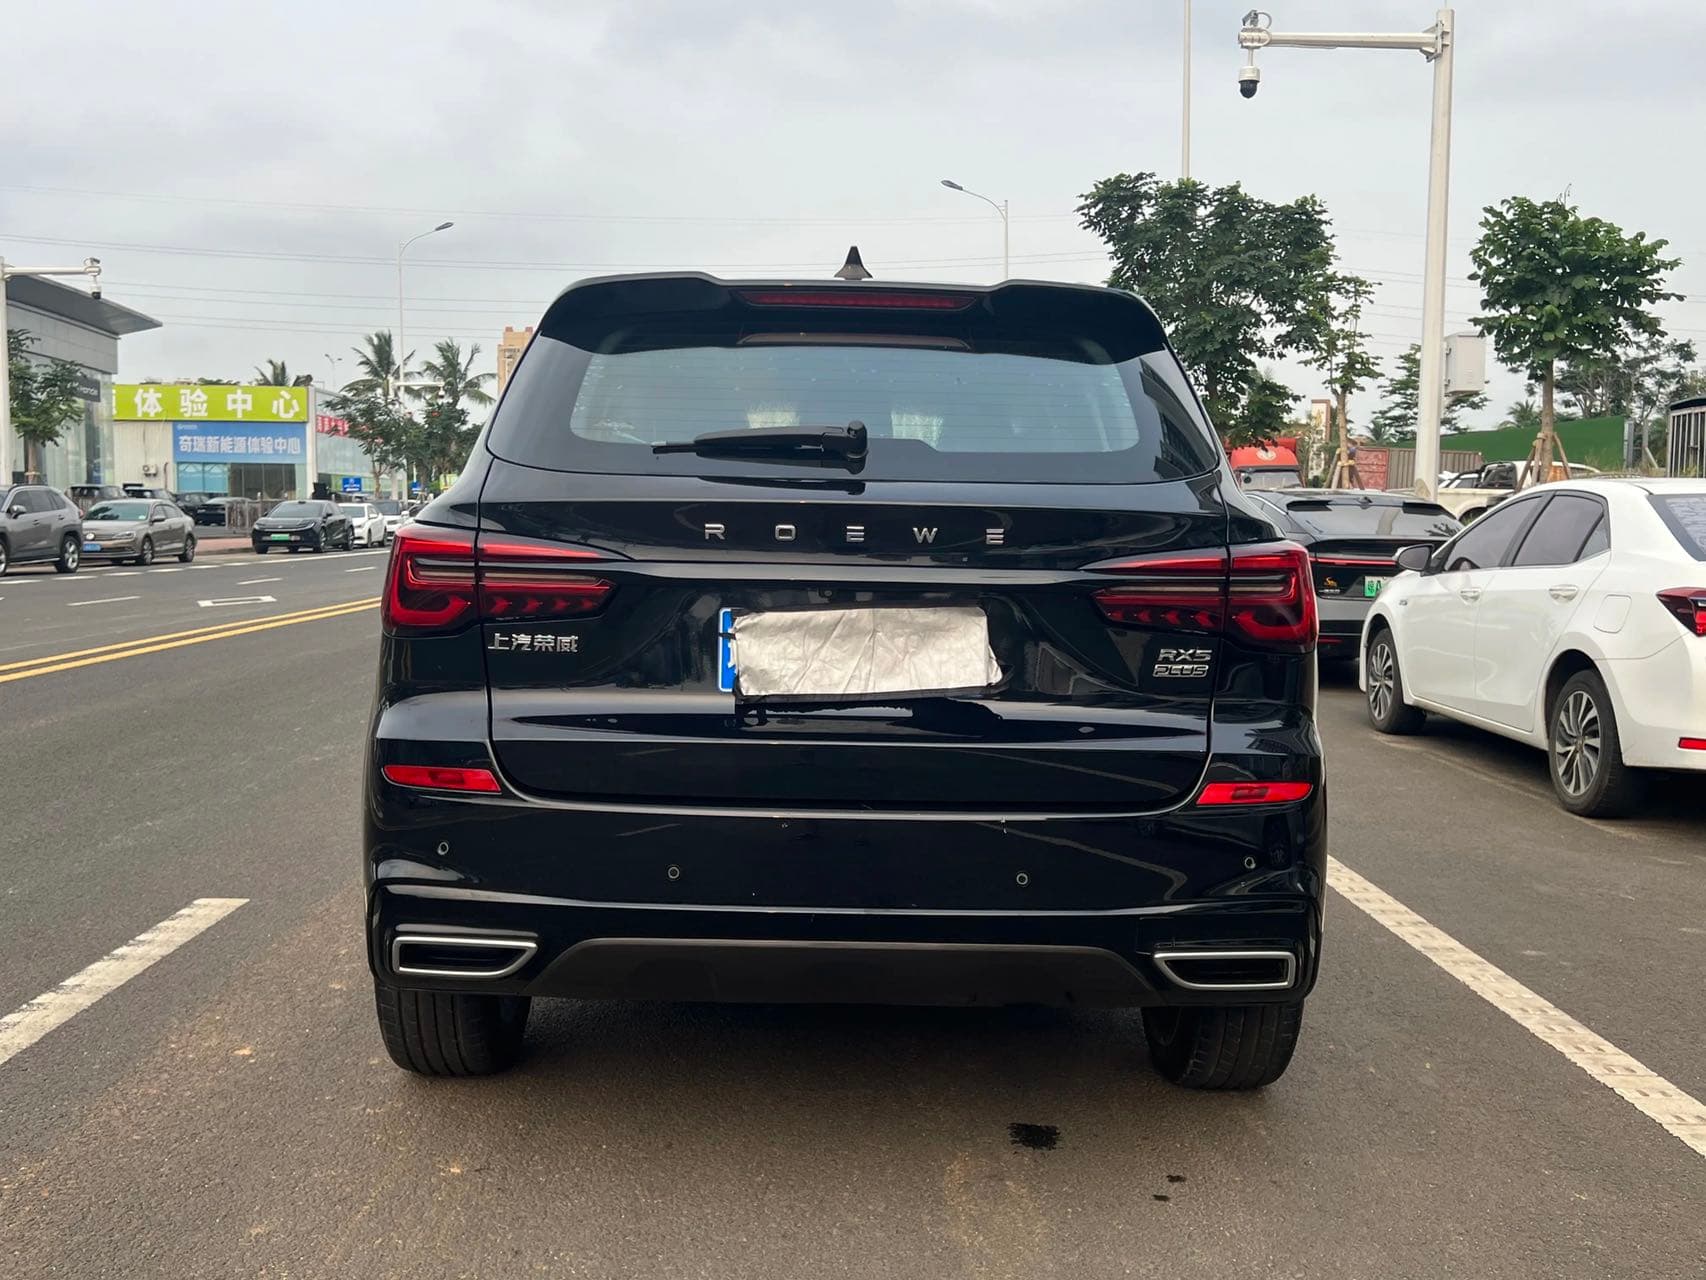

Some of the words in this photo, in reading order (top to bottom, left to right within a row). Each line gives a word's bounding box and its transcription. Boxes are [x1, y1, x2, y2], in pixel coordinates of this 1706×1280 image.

[704, 523, 1005, 546] ROEWE
[487, 633, 579, 652] 上汽荣威
[1157, 648, 1213, 662] RX5
[1152, 664, 1209, 678] PLUS
